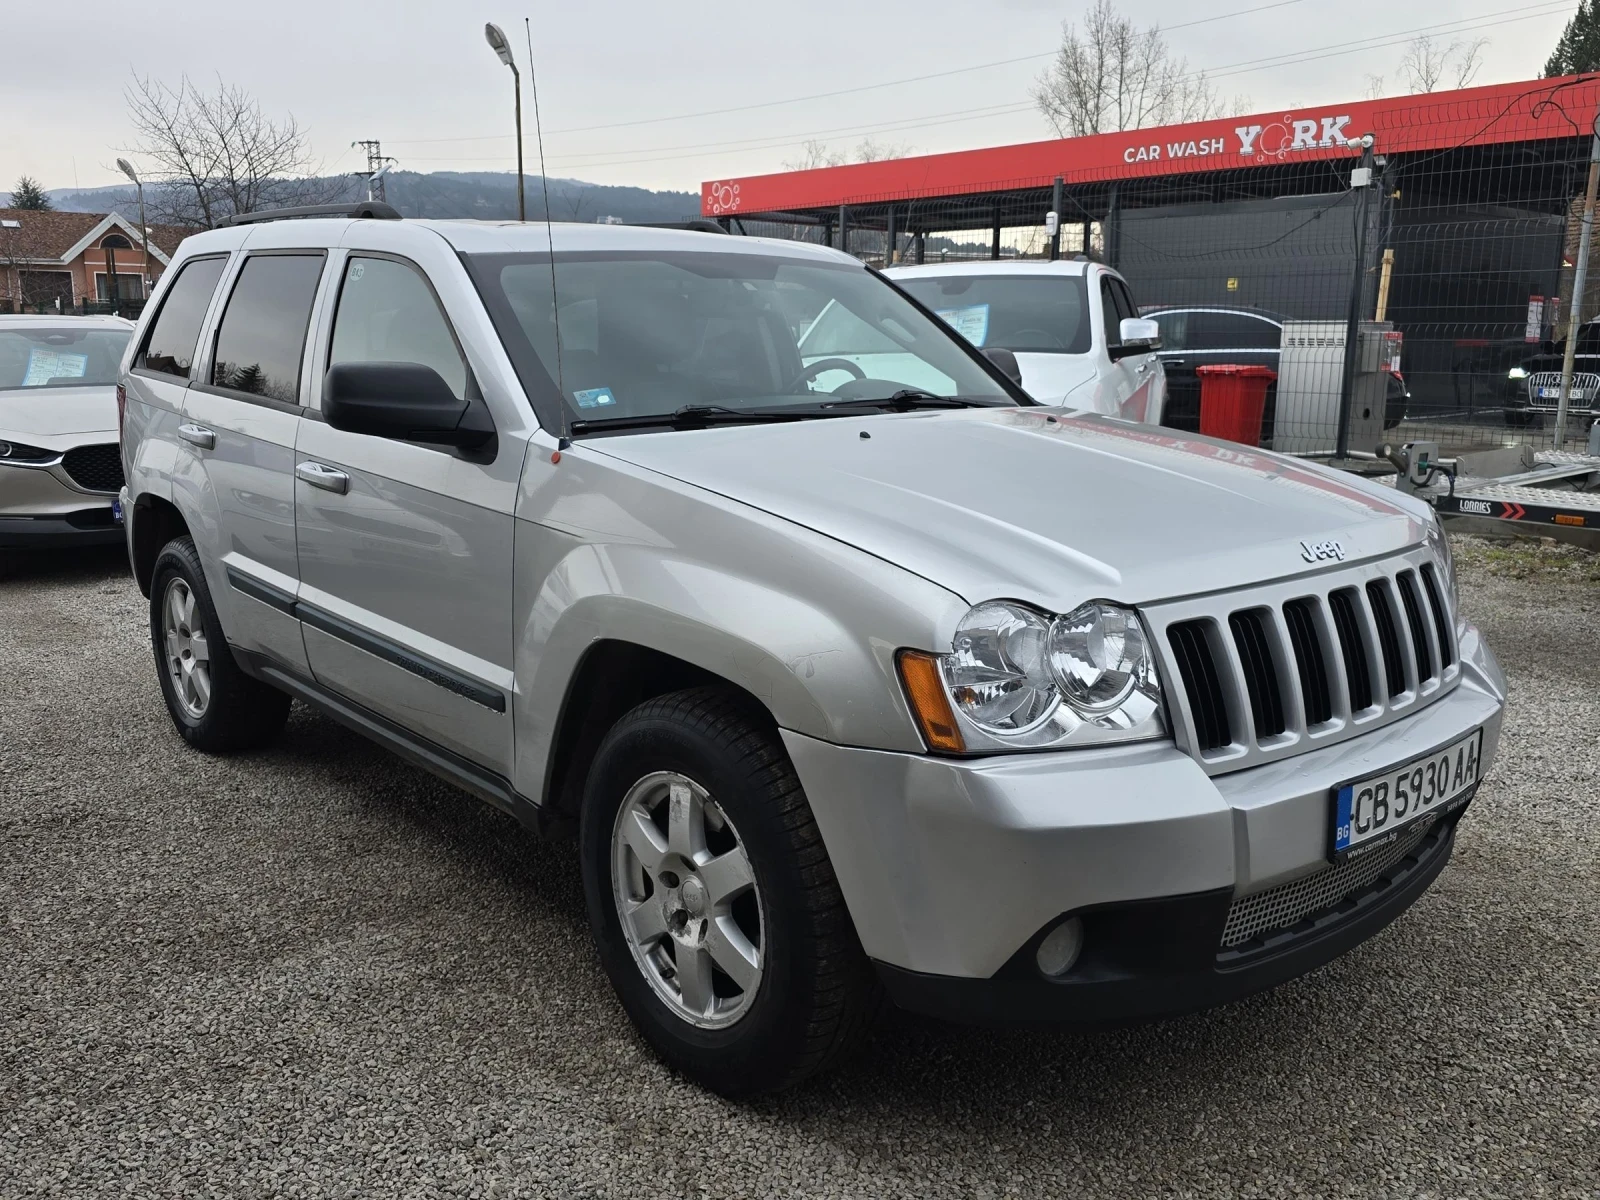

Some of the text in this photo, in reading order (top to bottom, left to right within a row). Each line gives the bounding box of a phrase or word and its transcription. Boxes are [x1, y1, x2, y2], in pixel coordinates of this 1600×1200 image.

[1123, 115, 1352, 163] CAR WASH YORK
[1459, 499, 1492, 514] LORRIES
[1300, 540, 1345, 563] Jeep
[1336, 824, 1350, 841] BG
